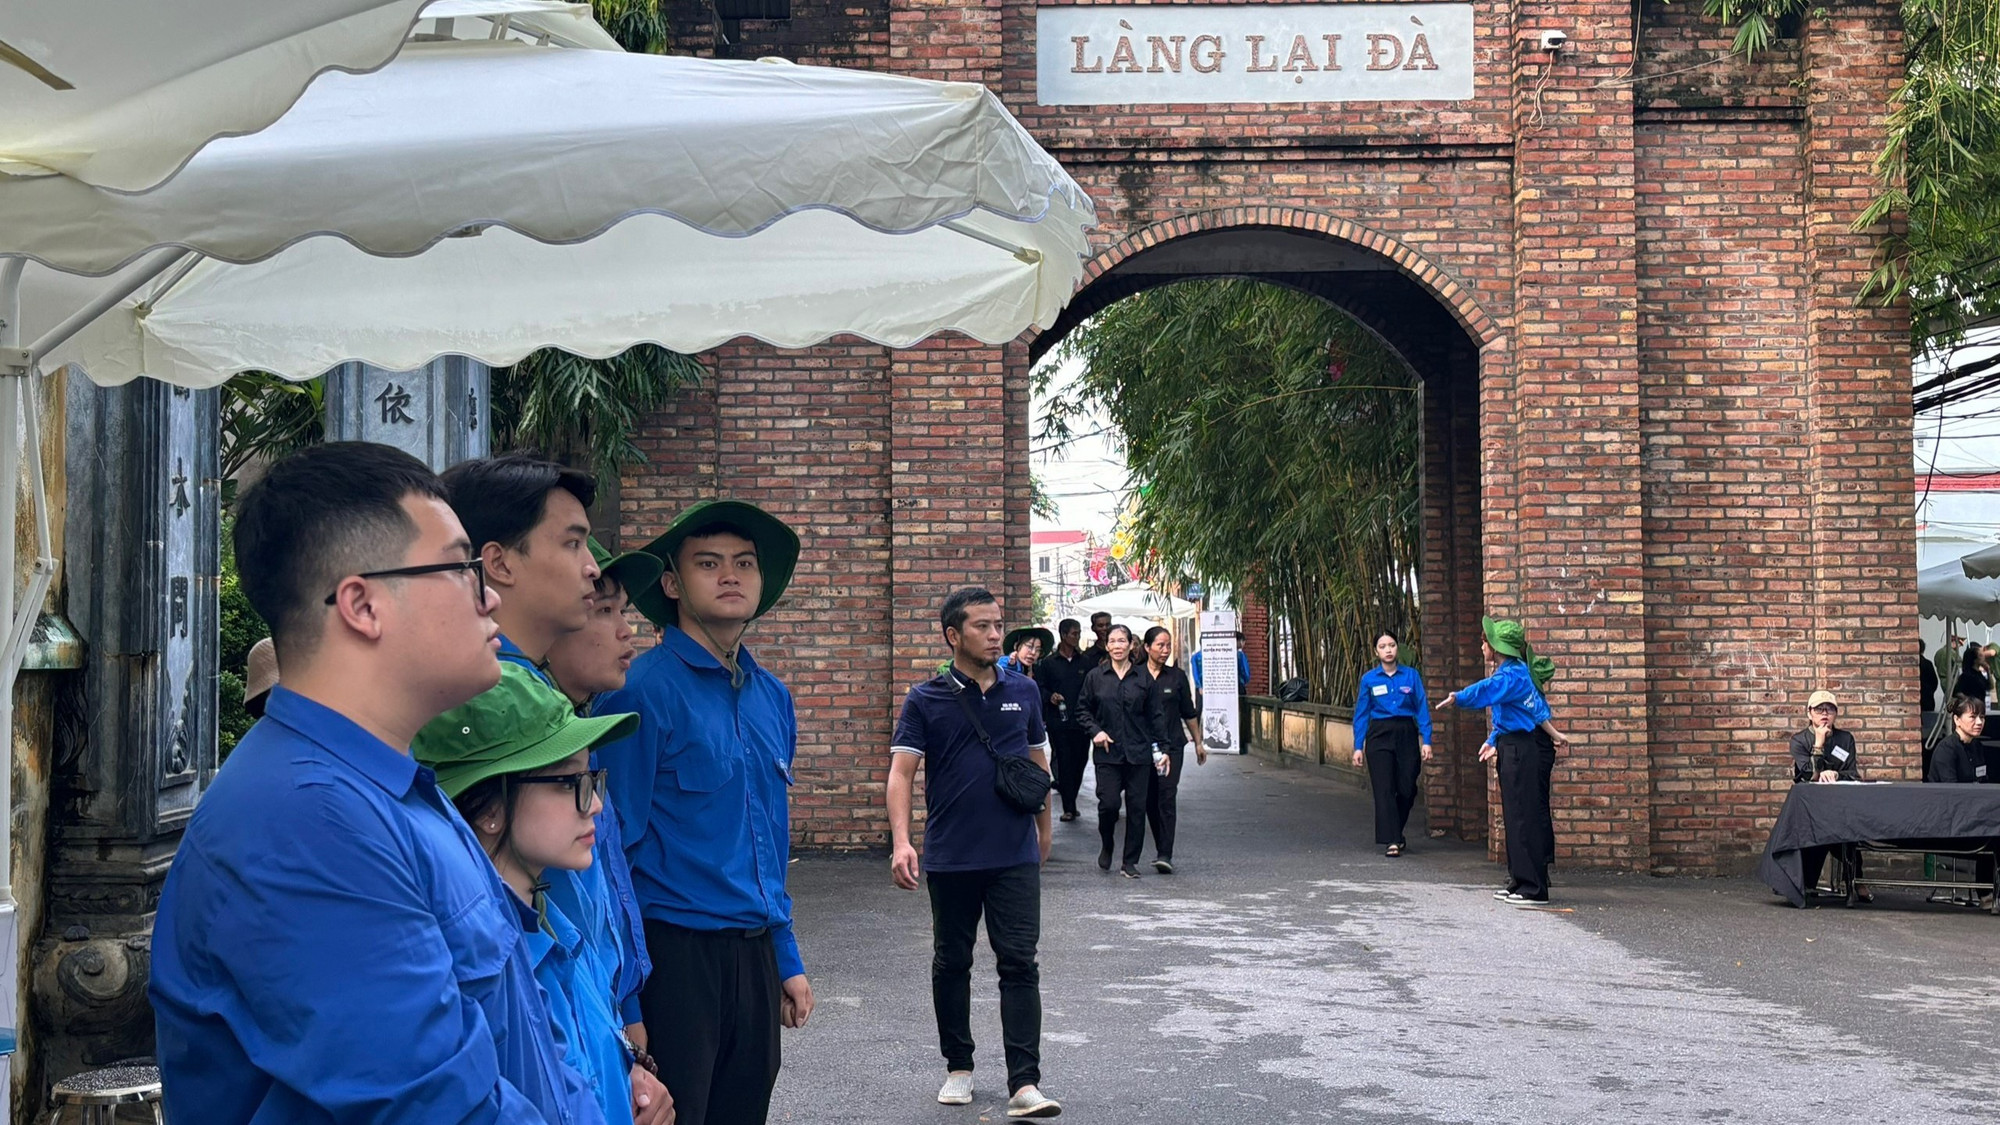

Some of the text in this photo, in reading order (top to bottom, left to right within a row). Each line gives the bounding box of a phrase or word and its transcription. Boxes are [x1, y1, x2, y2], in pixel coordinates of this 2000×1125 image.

[1071, 15, 1439, 84] LÀNG LẠI ĐÀ
[374, 382, 415, 424] 依
